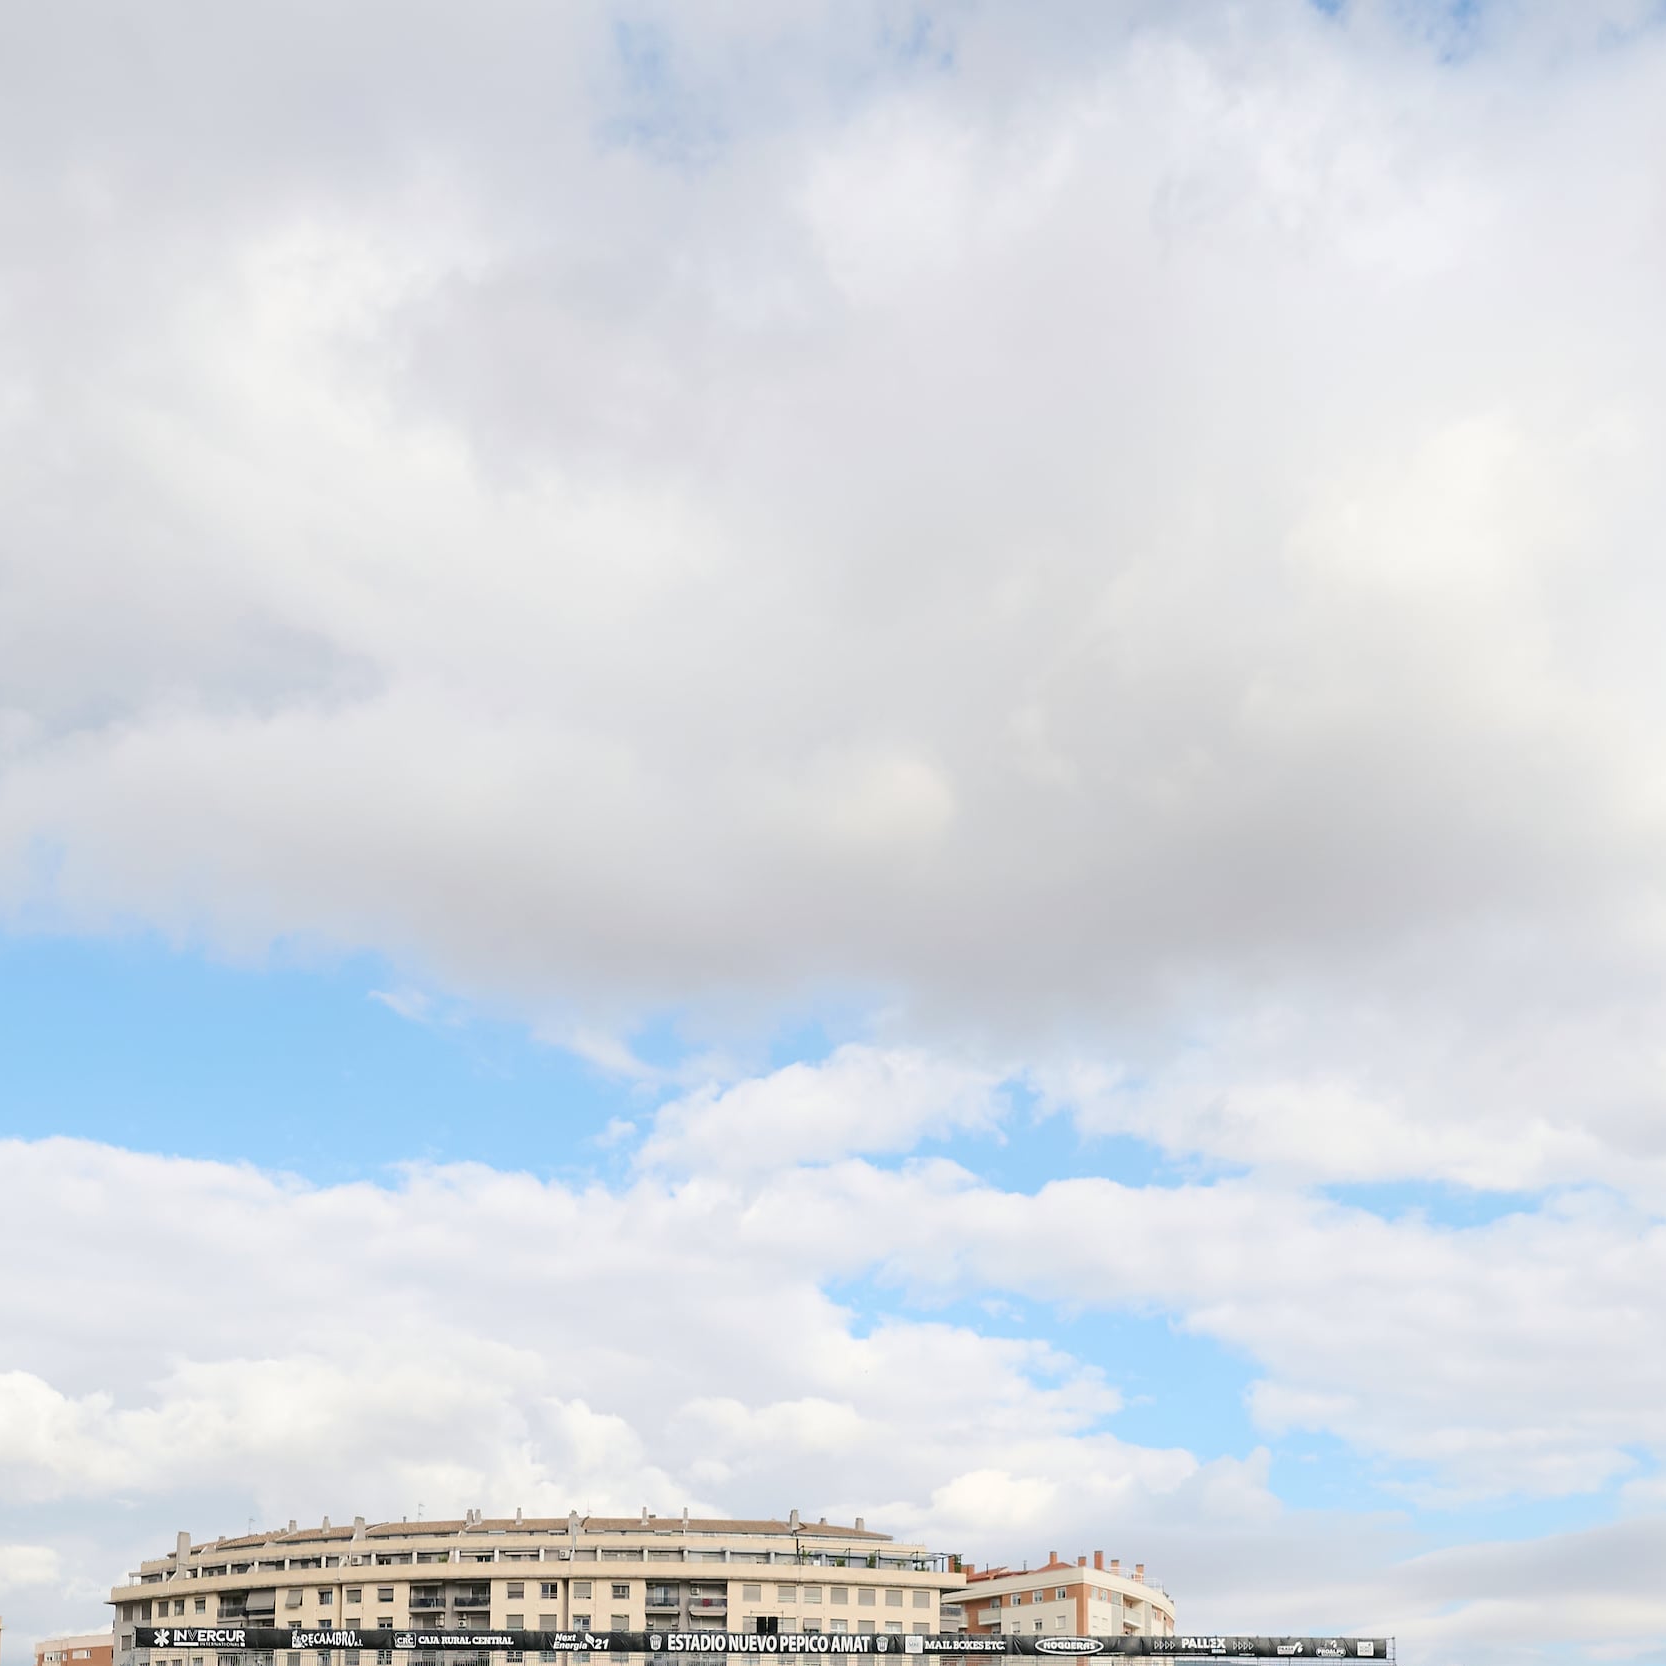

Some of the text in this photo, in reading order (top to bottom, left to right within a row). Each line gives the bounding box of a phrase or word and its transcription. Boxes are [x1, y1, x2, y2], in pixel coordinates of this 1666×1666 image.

[174, 1630, 245, 1642] INVERCUR
[397, 1636, 413, 1644] CRC
[418, 1636, 514, 1645] CAJA RURAL CENTRAL
[555, 1633, 576, 1642] Next
[595, 1639, 609, 1649] 21
[667, 1635, 869, 1652] ESTADIO NUEVO PEPICO AMAT
[925, 1640, 952, 1650] MAIL
[953, 1640, 983, 1650] BOXES
[985, 1640, 1005, 1650] ETC.
[1044, 1641, 1096, 1650] NOGUERAS
